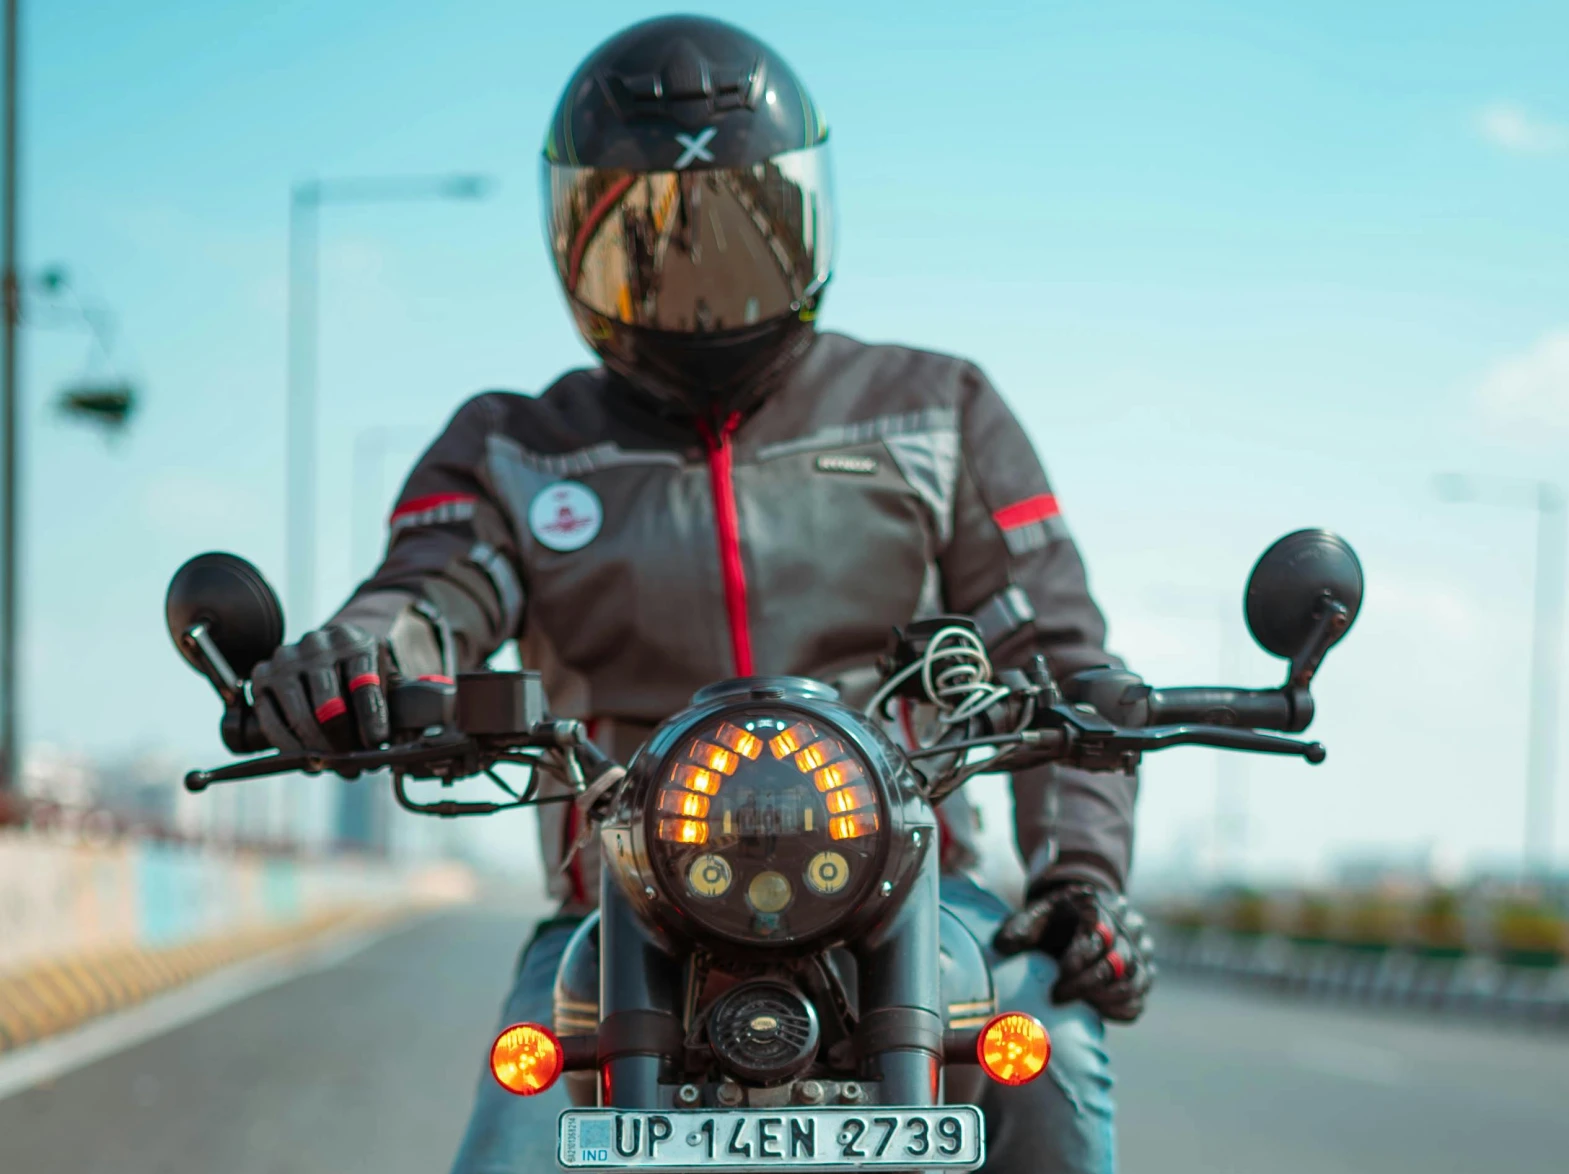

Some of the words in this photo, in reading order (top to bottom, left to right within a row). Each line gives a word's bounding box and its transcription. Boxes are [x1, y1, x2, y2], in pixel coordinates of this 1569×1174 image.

[615, 1115, 671, 1157] UP
[700, 1117, 815, 1158] 14EN
[842, 1116, 962, 1157] 2739
[582, 1149, 608, 1161] IND
